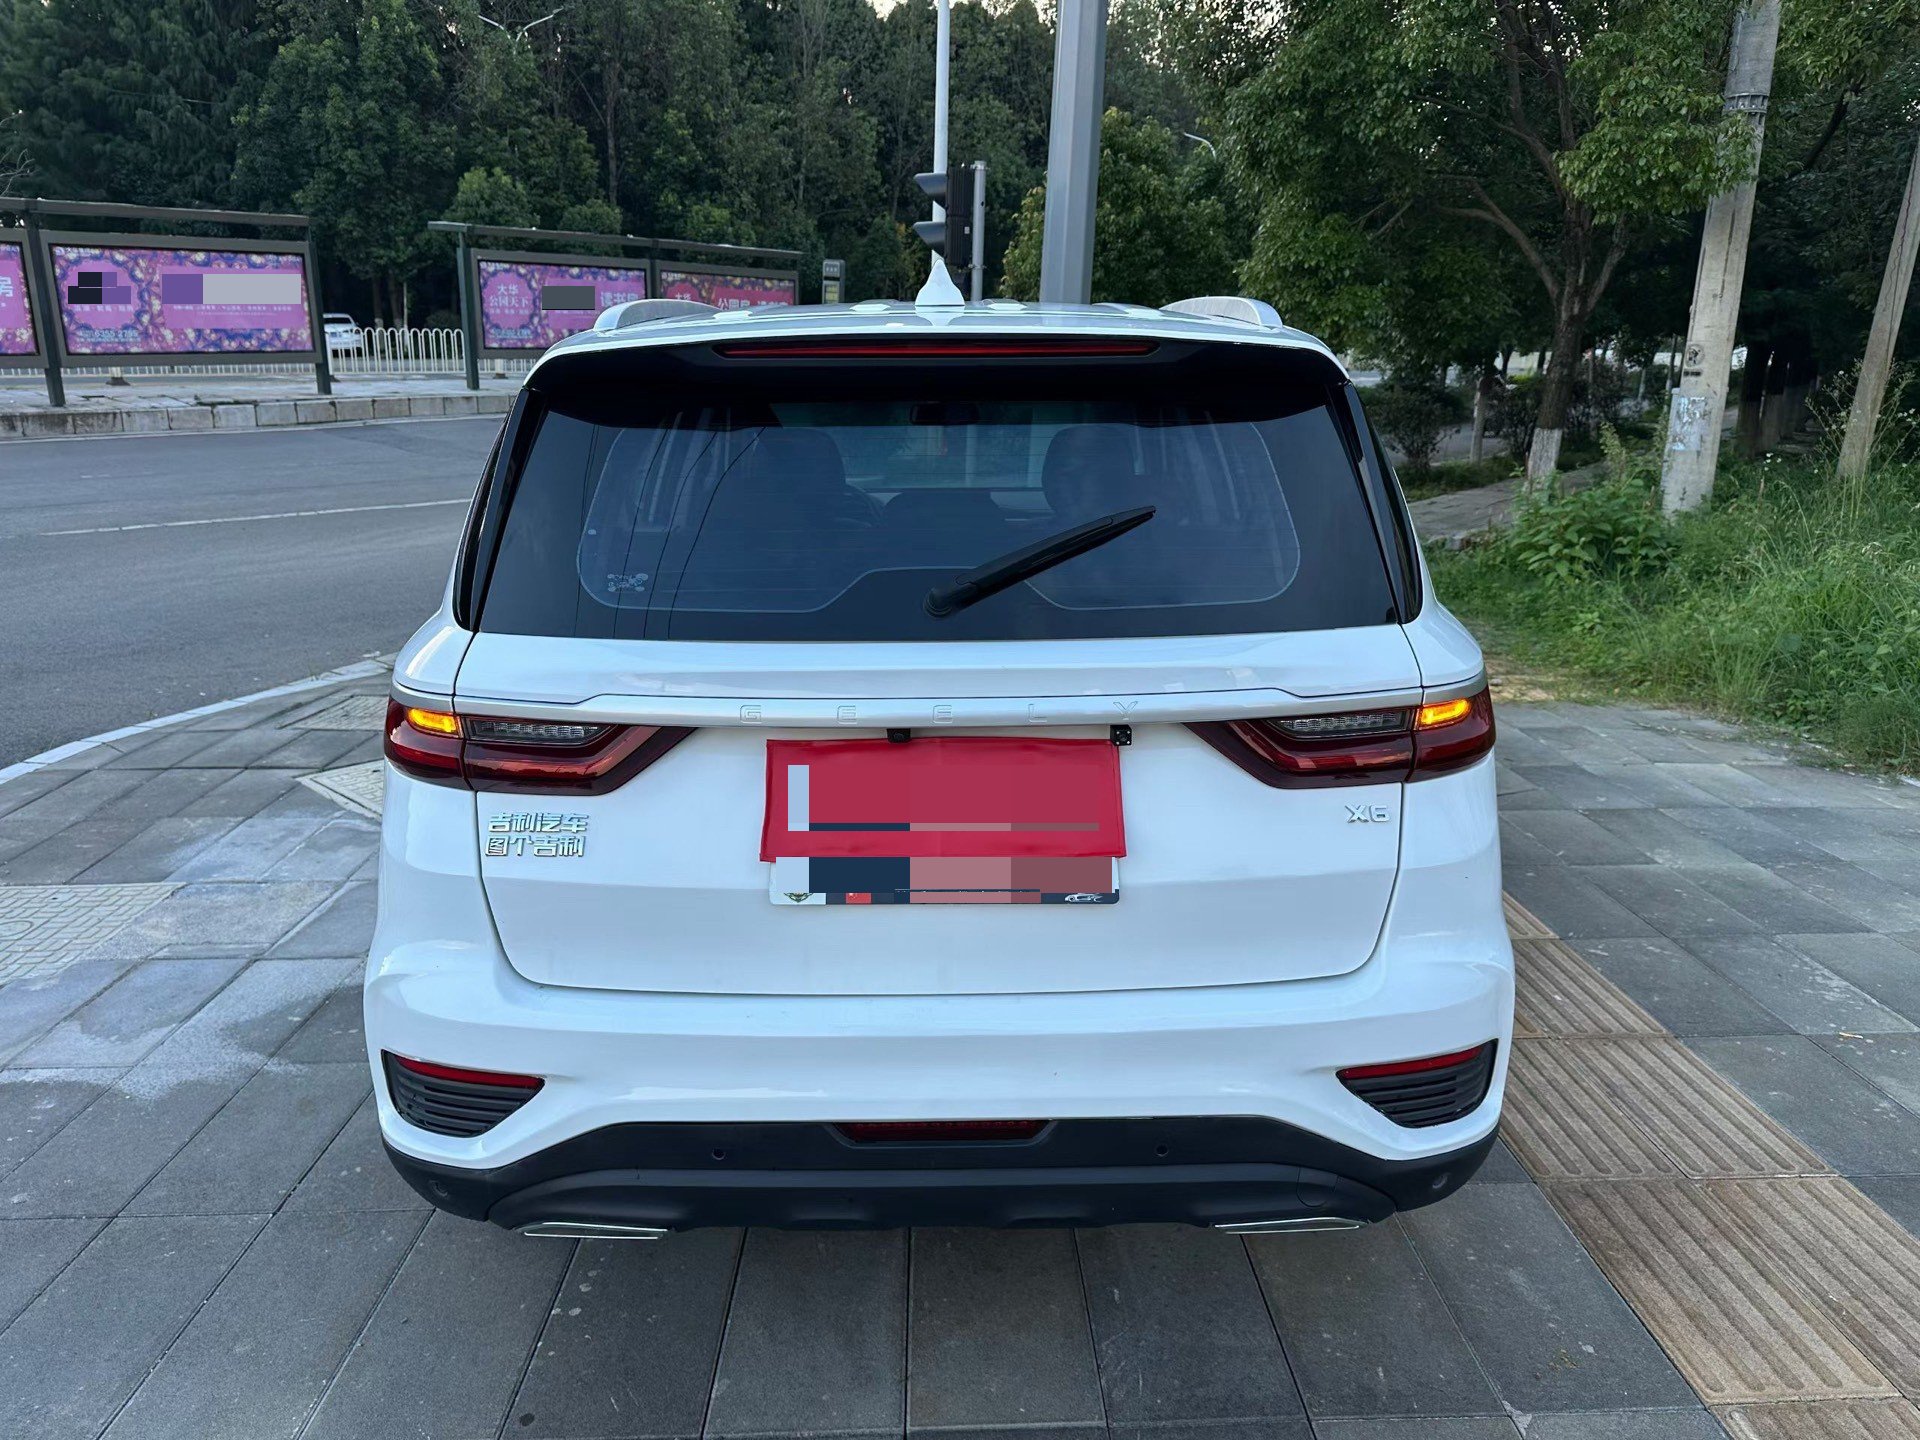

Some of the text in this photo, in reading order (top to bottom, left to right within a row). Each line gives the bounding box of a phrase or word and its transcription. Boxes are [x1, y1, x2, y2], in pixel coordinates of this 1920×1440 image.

[497, 284, 519, 295] 大华
[489, 296, 529, 307] 公园天下
[739, 700, 1139, 725] GEELY
[488, 811, 590, 834] 吉利汽车
[1345, 804, 1389, 823] X6
[485, 834, 588, 857] 图个吉利
